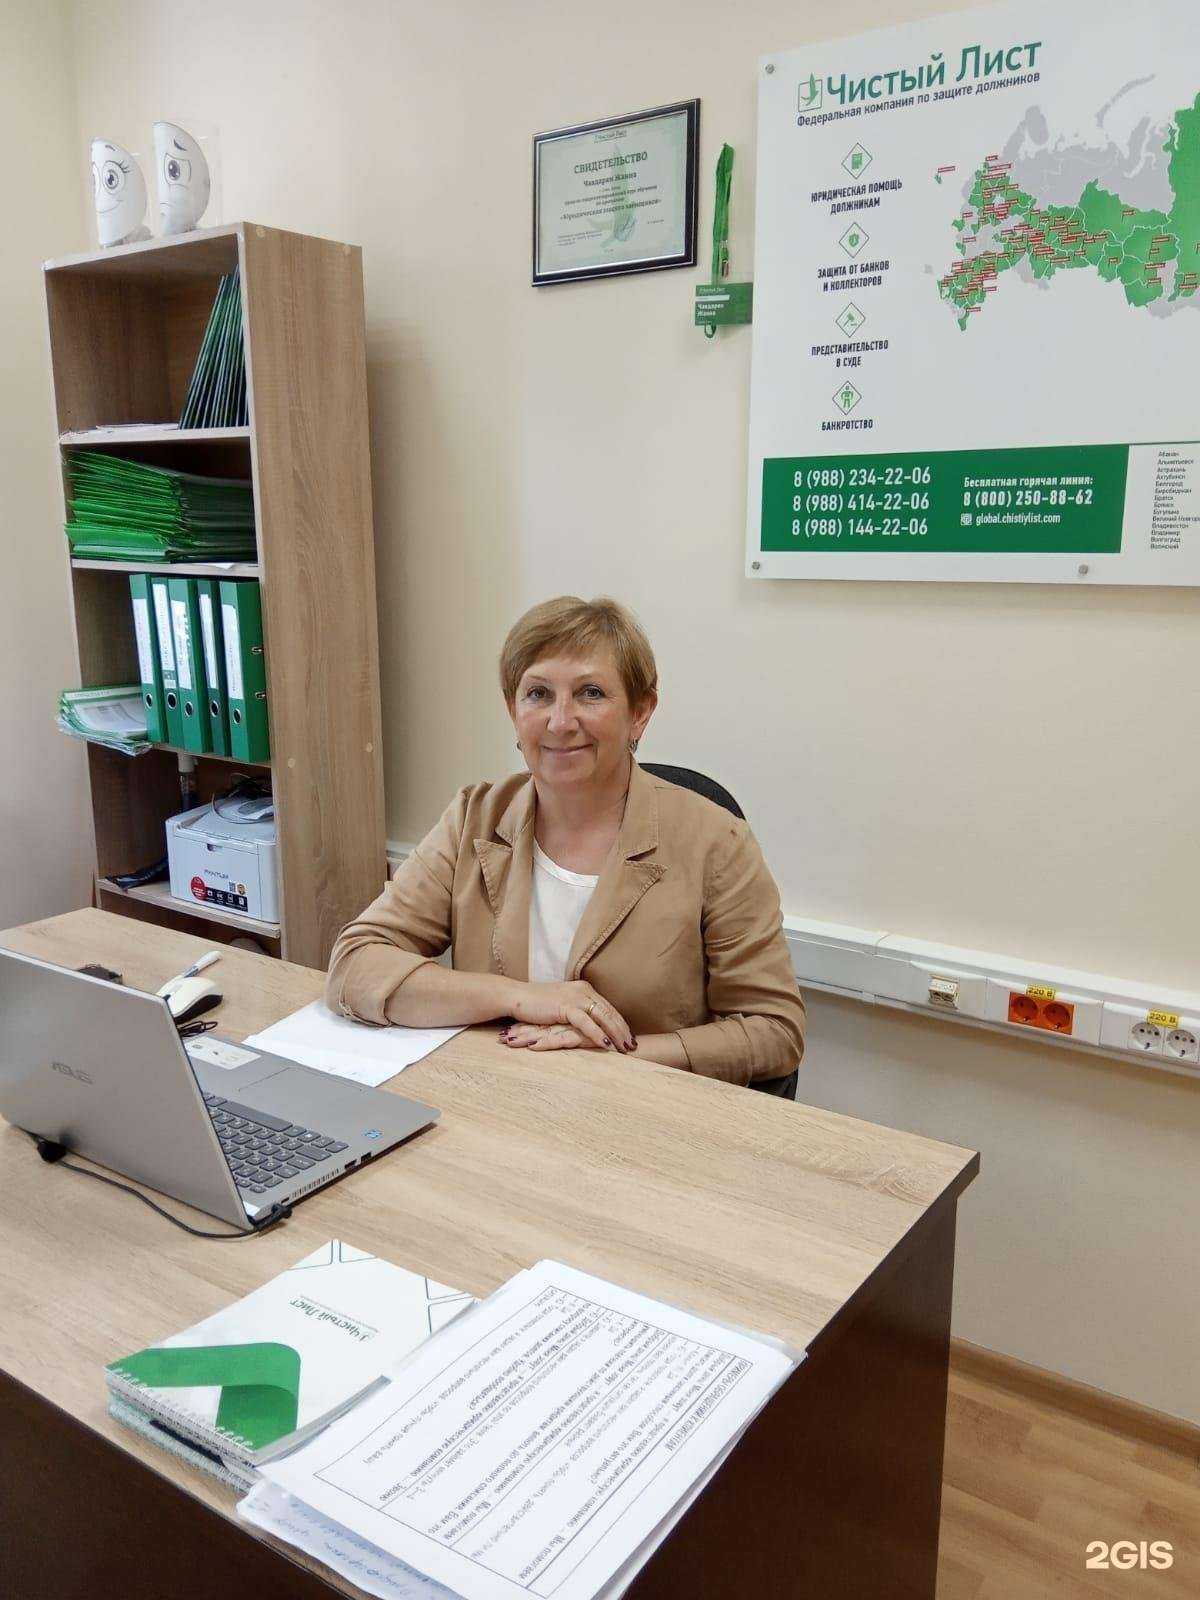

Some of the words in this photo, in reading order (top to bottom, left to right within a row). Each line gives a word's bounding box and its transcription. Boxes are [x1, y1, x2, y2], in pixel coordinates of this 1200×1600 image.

[827, 52, 945, 105] Чистый
[955, 41, 1042, 82] Лист
[797, 107, 861, 126] Федеральная
[864, 96, 914, 114] компания
[917, 94, 930, 104] по
[933, 85, 973, 101] защите
[975, 72, 1041, 95] должников
[574, 151, 648, 174] СВИДЕТЕЛЬСТВО
[811, 184, 867, 203] ЮРИДИЧЕСКАЯ
[868, 178, 903, 194] ПОМОЩЬ
[830, 197, 881, 216] ДОЛЖНИКАМ
[817, 266, 847, 279] ЗАЩИТА
[849, 264, 858, 275] ОТ
[860, 260, 890, 274] БАНКОВ
[823, 282, 829, 292] И
[830, 275, 882, 291] КОЛЛЕКТОРОВ
[811, 339, 889, 356] ПРЕДСТАВИТЕЛЬСТВО
[836, 358, 841, 368] В
[843, 356, 862, 367] СУДЕ
[821, 419, 874, 431] БАНКРОТСТВО
[794, 470, 802, 488] 8
[806, 468, 845, 490] (988)
[848, 466, 931, 486] 234-22-06
[964, 477, 1017, 488] Бесплатная
[1019, 477, 1058, 488] горячая
[1060, 476, 1094, 486] линия:
[793, 495, 801, 512] 8
[805, 493, 844, 514] (988)
[847, 492, 930, 511] 414-22-06
[963, 492, 971, 507] 8
[975, 491, 1012, 508] (800)
[1015, 489, 1093, 506] 250-88-62
[792, 519, 800, 536] 8
[804, 518, 843, 538] (988)
[847, 518, 928, 536] 144-22-06
[976, 512, 1061, 527] global.chistiylist.com
[1028, 988, 1044, 996] 220
[1149, 1012, 1167, 1022] 220
[289, 1299, 320, 1316] Лист
[318, 1310, 360, 1338] Чистый
[720, 1360, 749, 1386] ПРИМЕРЫ
[521, 1426, 567, 1466] юридическую
[662, 1420, 696, 1451] КЛИЕНТАМ
[406, 1446, 446, 1478] компанию
[482, 1457, 514, 1483] полного
[490, 1462, 529, 1495] компанию
[376, 1481, 407, 1504] Звоню
[472, 1499, 492, 1513] Мы
[564, 1495, 600, 1530] компанию
[437, 1510, 459, 1526] Вам
[442, 1510, 480, 1542] помогаем
[547, 1534, 565, 1549] Мы
[517, 1546, 554, 1581] помогаем
